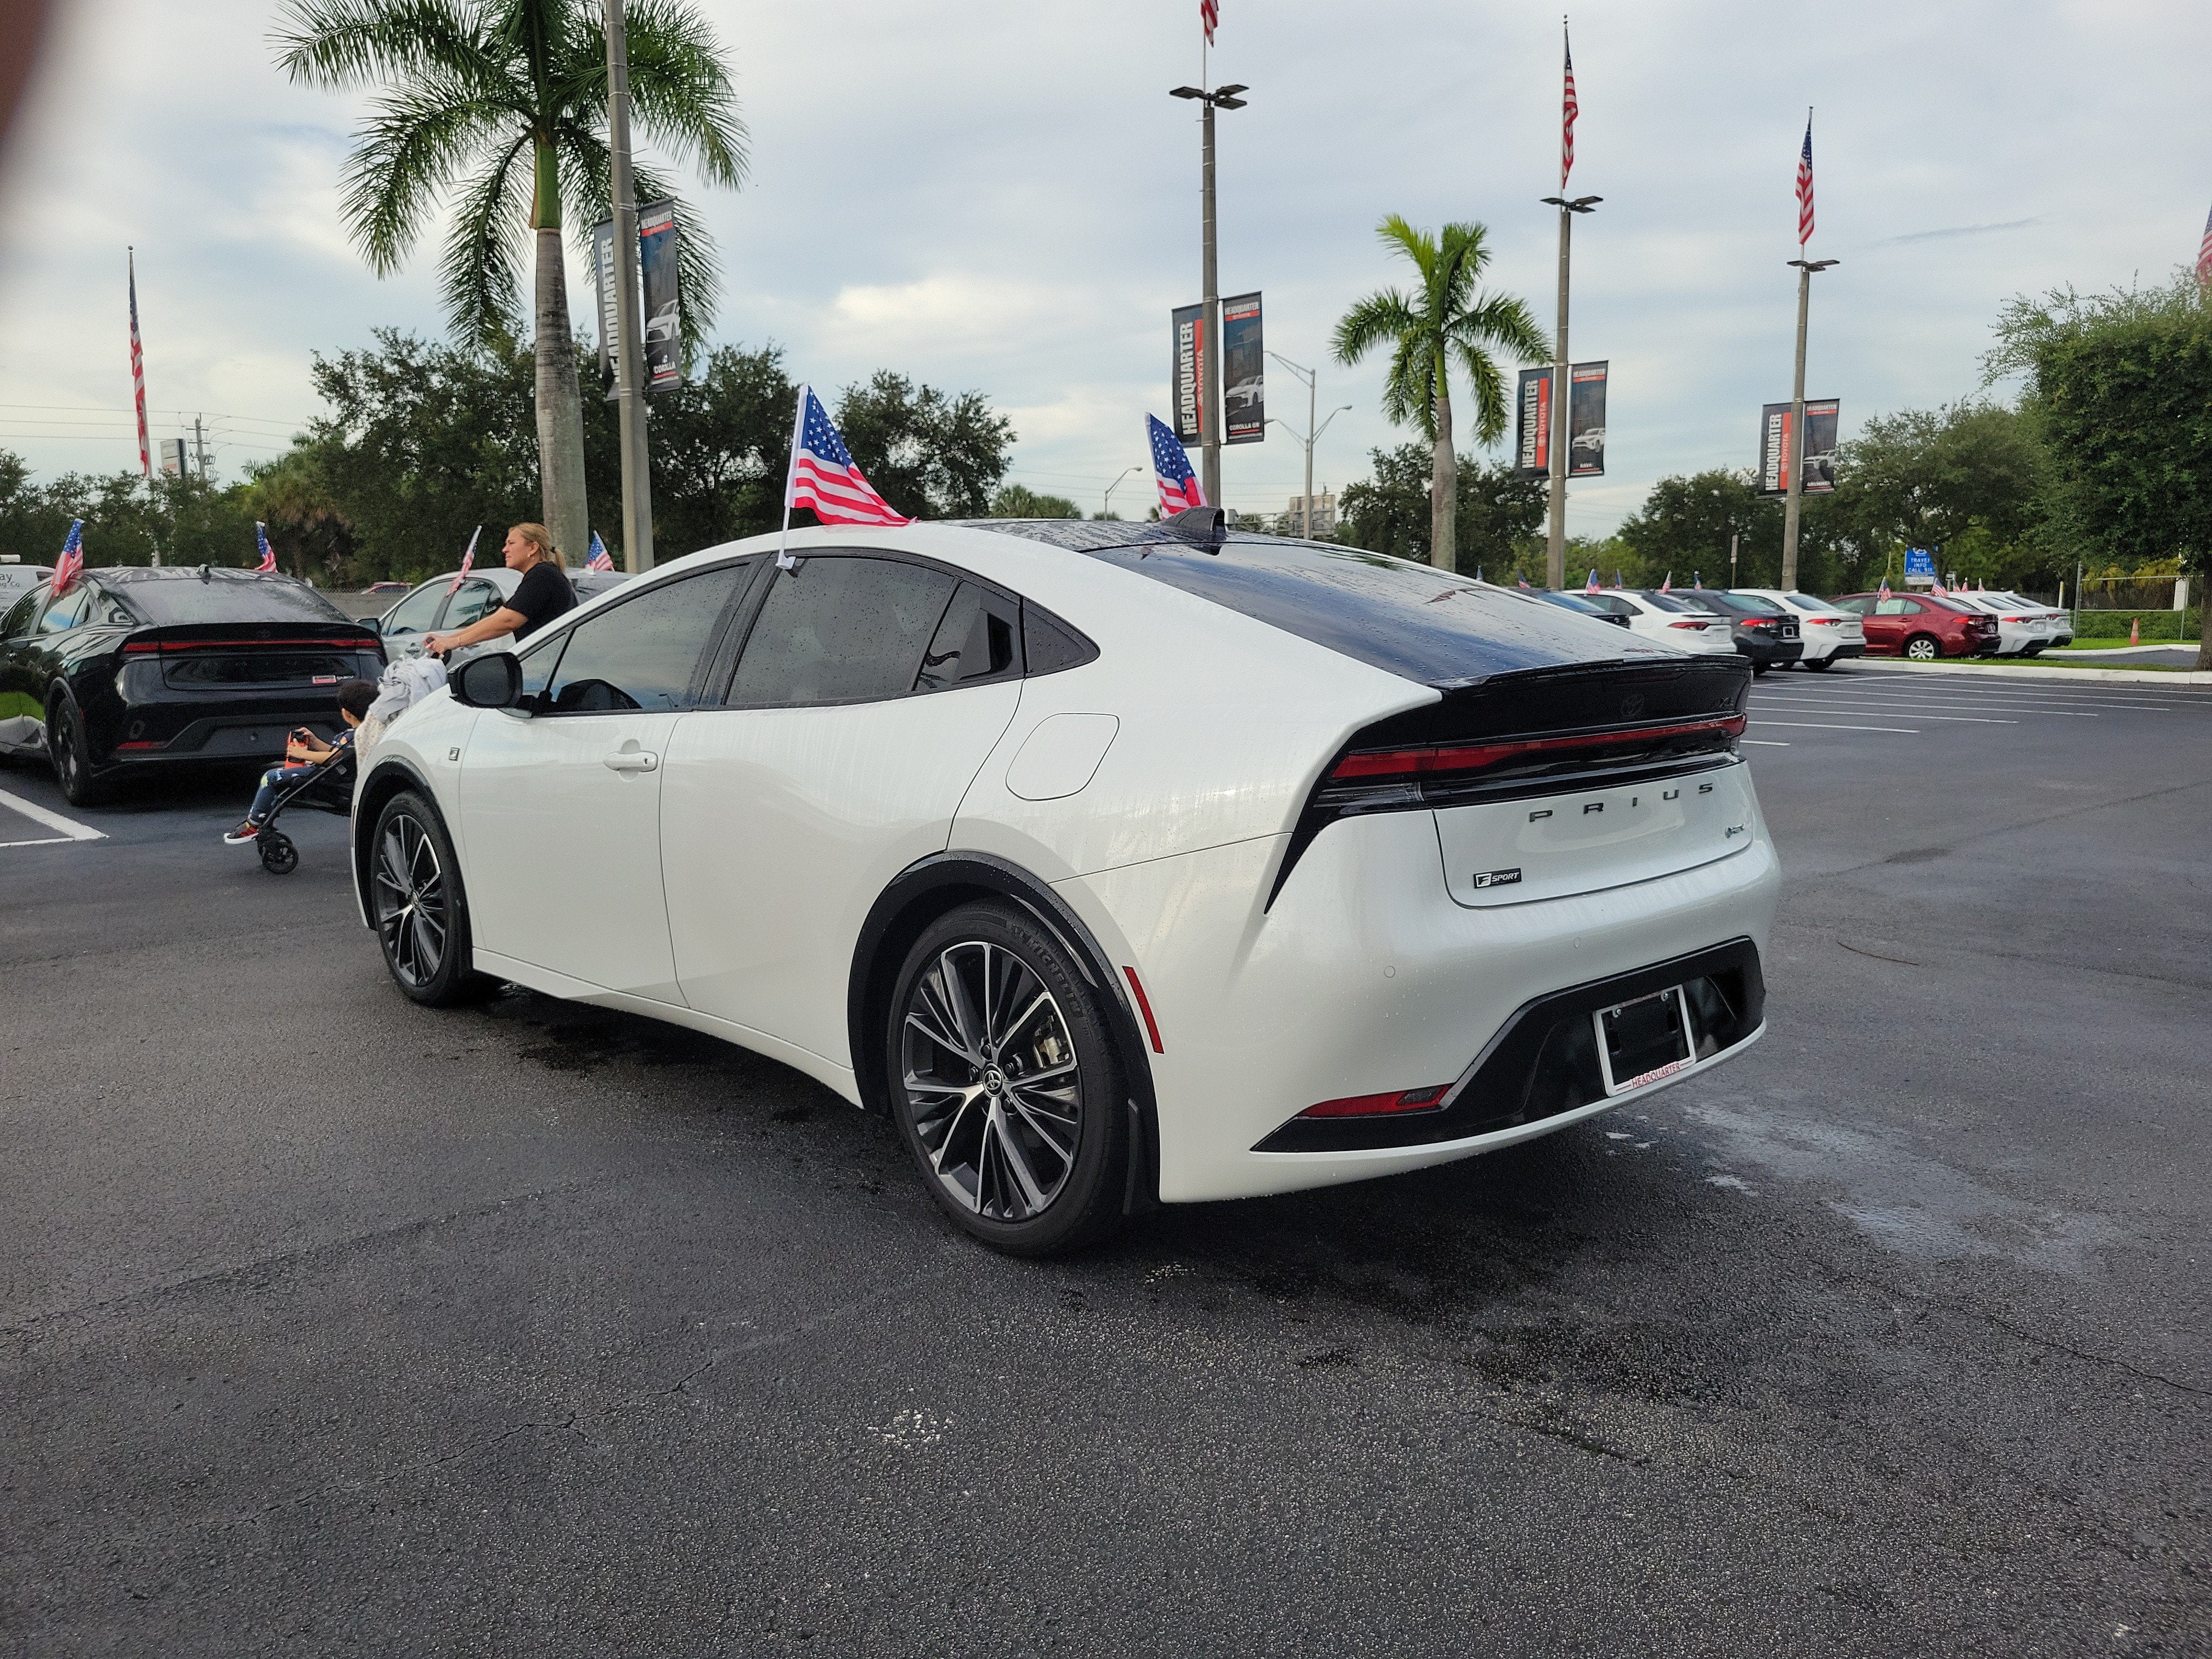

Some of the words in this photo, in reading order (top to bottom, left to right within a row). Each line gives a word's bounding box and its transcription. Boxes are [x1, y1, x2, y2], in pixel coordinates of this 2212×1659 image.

[1180, 321, 1198, 435] HEADQUARTER
[1522, 380, 1539, 469] HEADQUARTER
[1765, 413, 1782, 491] HEADQUARTER
[1529, 782, 1713, 822] PRIUS
[1491, 872, 1519, 882] SPORT
[1632, 1062, 1680, 1087] HEADQUARTER
